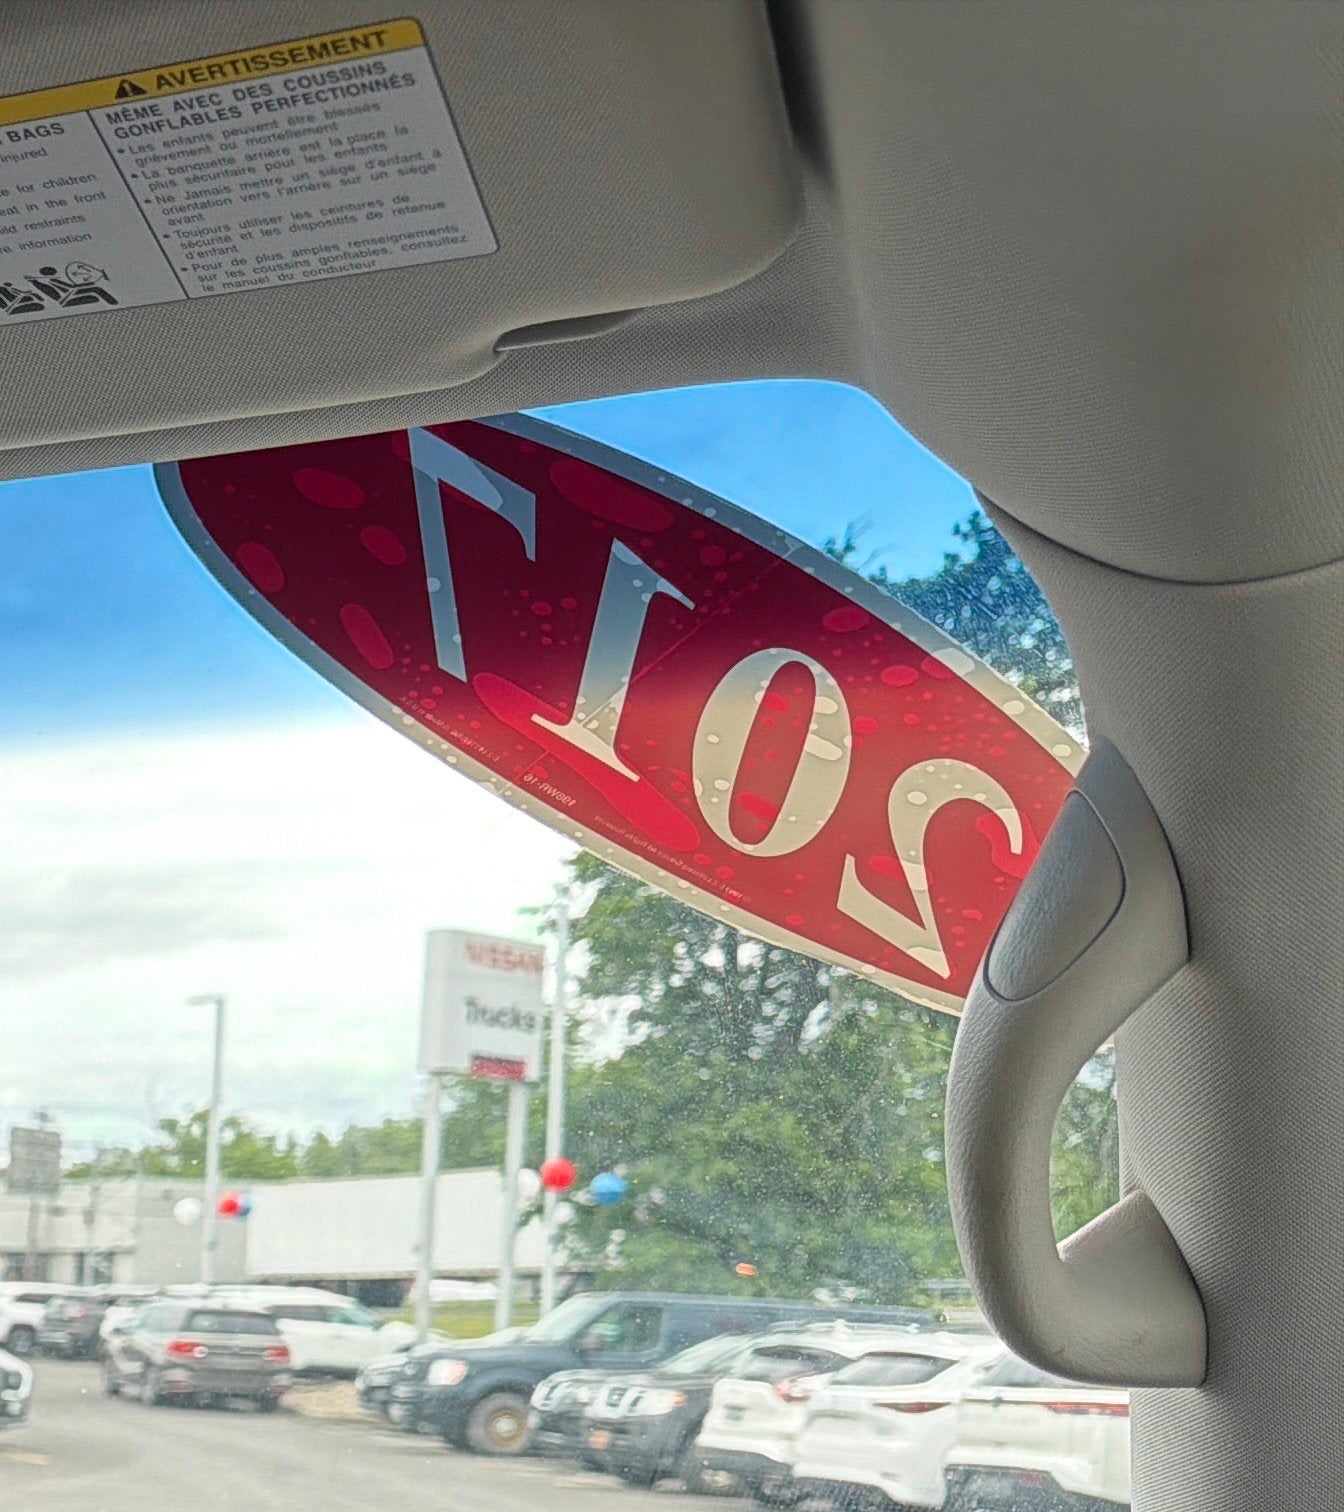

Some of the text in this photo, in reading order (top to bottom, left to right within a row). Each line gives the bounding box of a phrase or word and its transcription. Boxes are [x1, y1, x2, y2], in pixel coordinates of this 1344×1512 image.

[150, 29, 390, 90] AVERTISSEMENT
[168, 91, 225, 113] AVEC
[229, 82, 275, 102] DES
[280, 60, 389, 92] COUSSINS
[4, 121, 67, 143] BAGS
[111, 104, 244, 140] GONFLABLES
[39, 172, 99, 189] children
[43, 197, 69, 209] the
[16, 232, 94, 251] information
